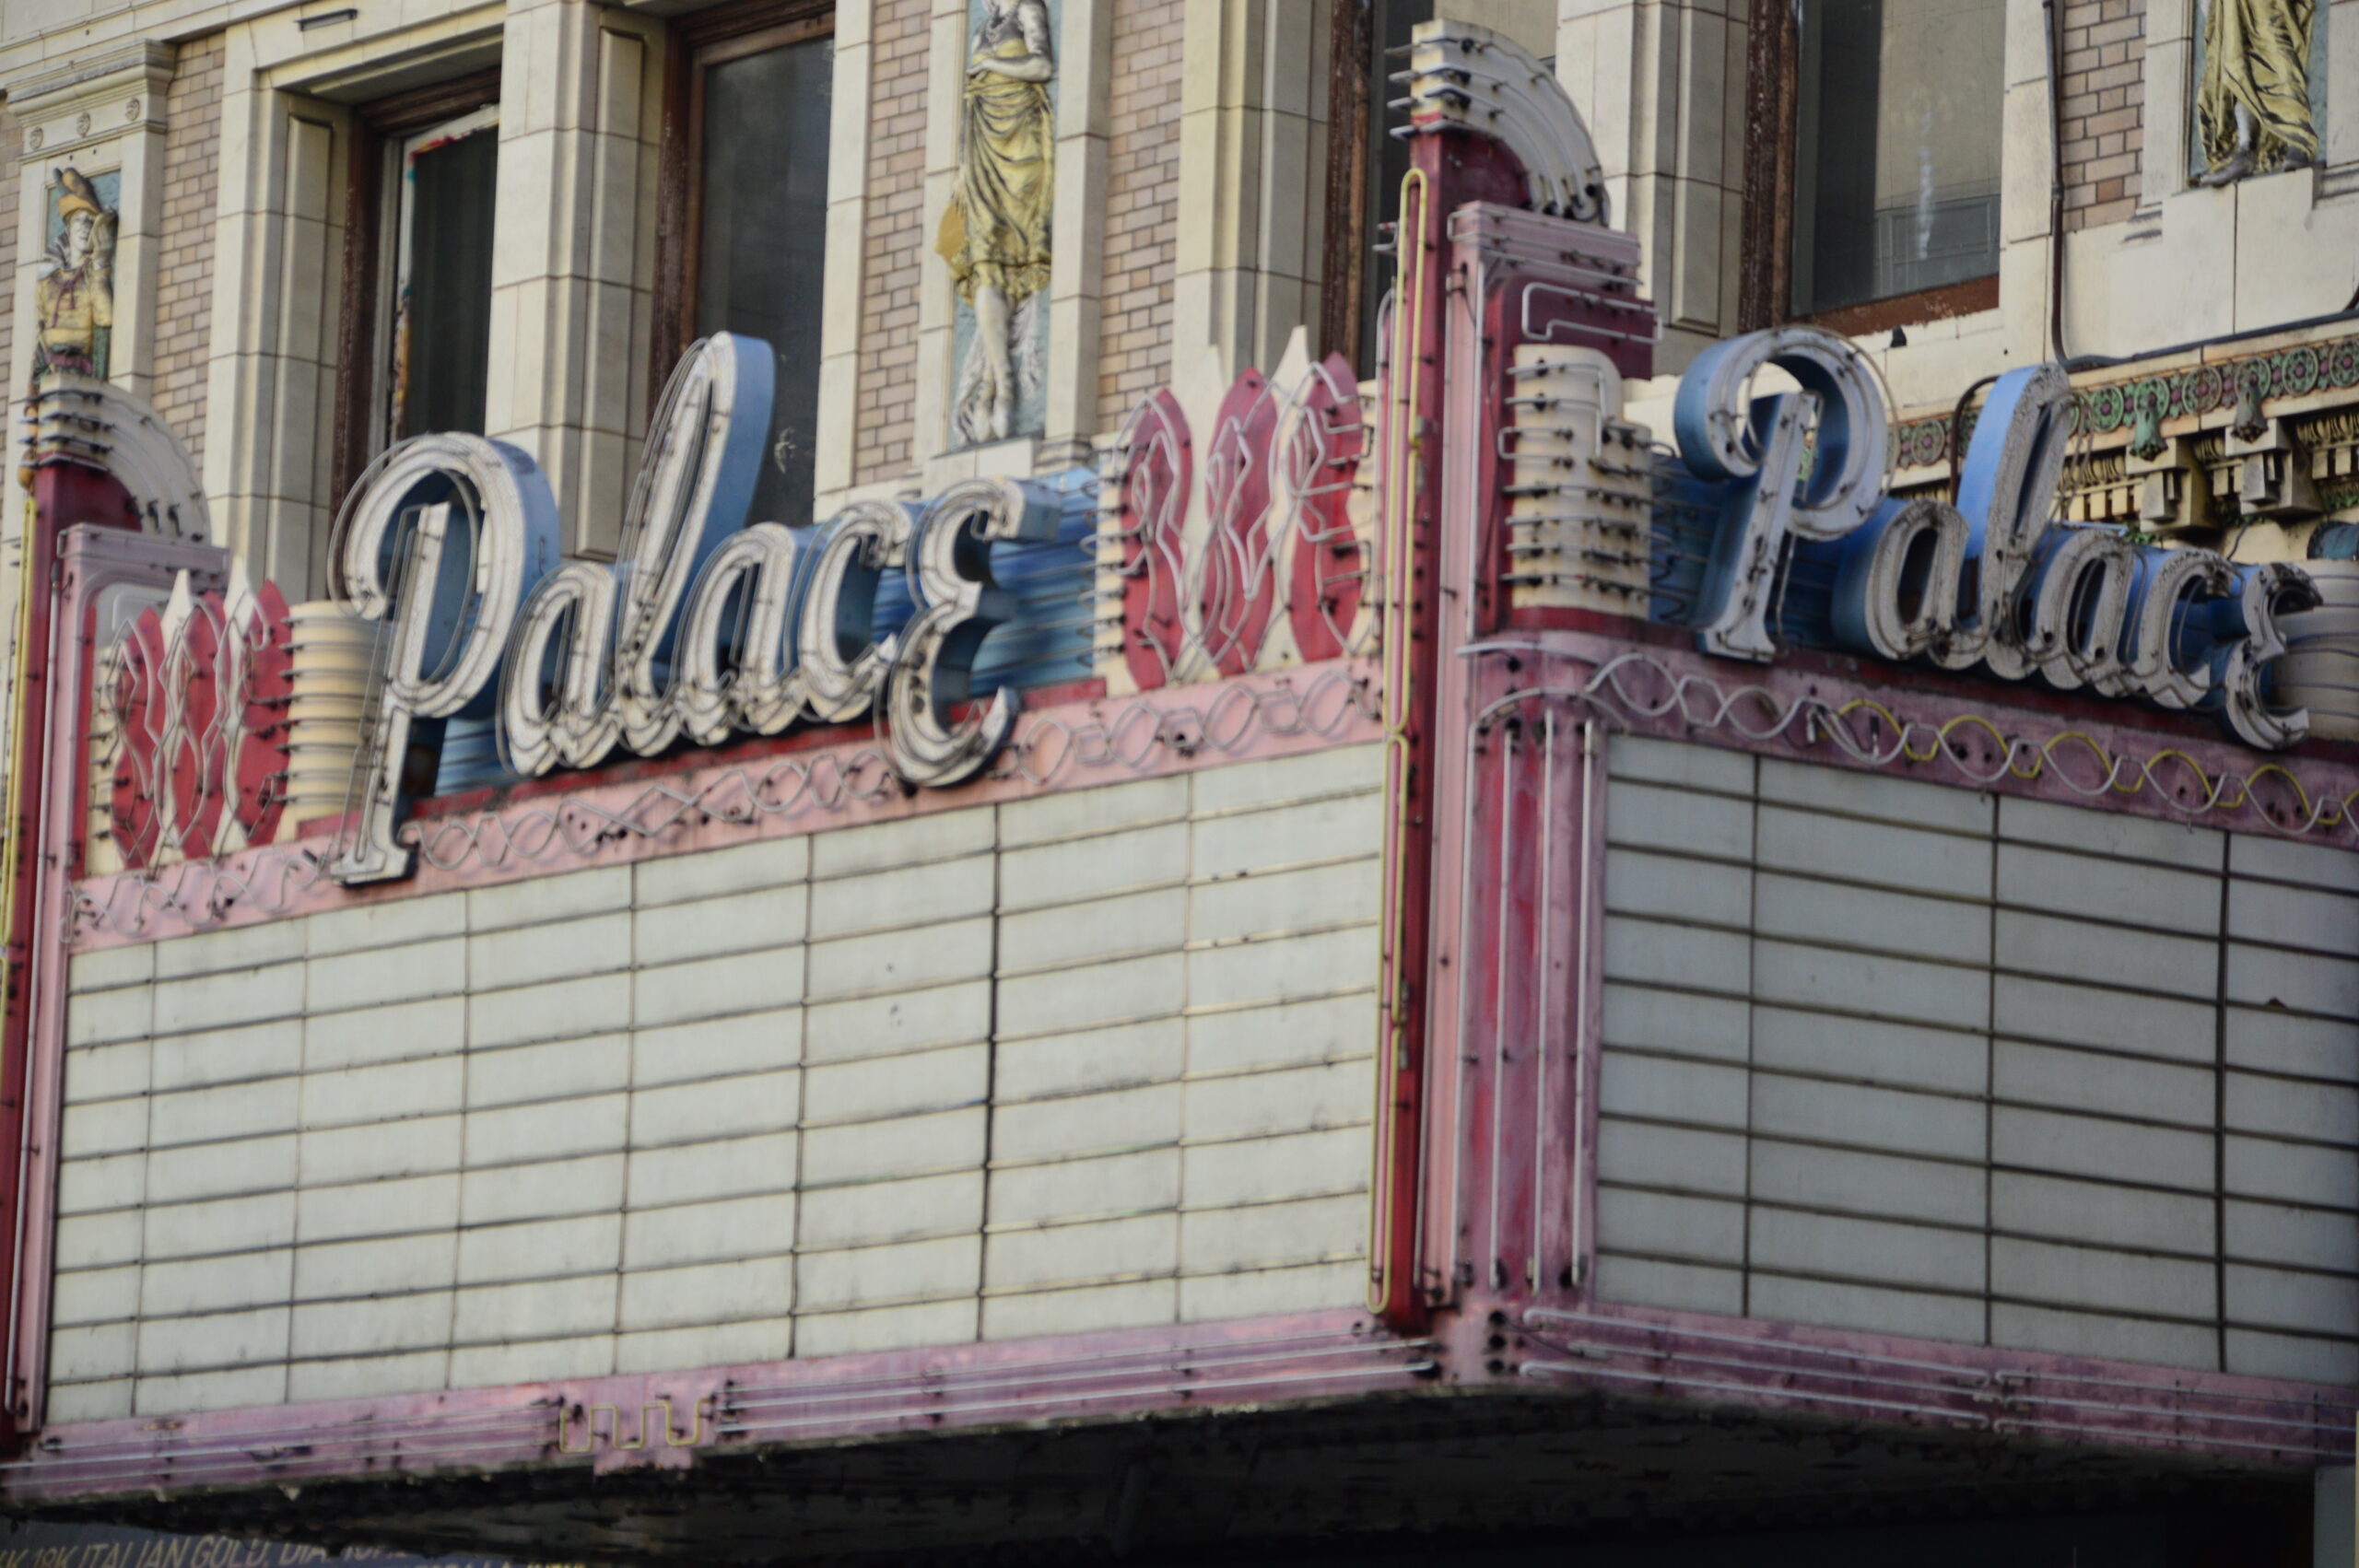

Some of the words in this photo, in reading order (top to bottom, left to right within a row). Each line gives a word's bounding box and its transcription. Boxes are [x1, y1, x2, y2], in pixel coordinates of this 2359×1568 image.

[329, 330, 1027, 884] Palace
[1677, 322, 2323, 751] Palace
[77, 1536, 192, 1568] ITALIAN
